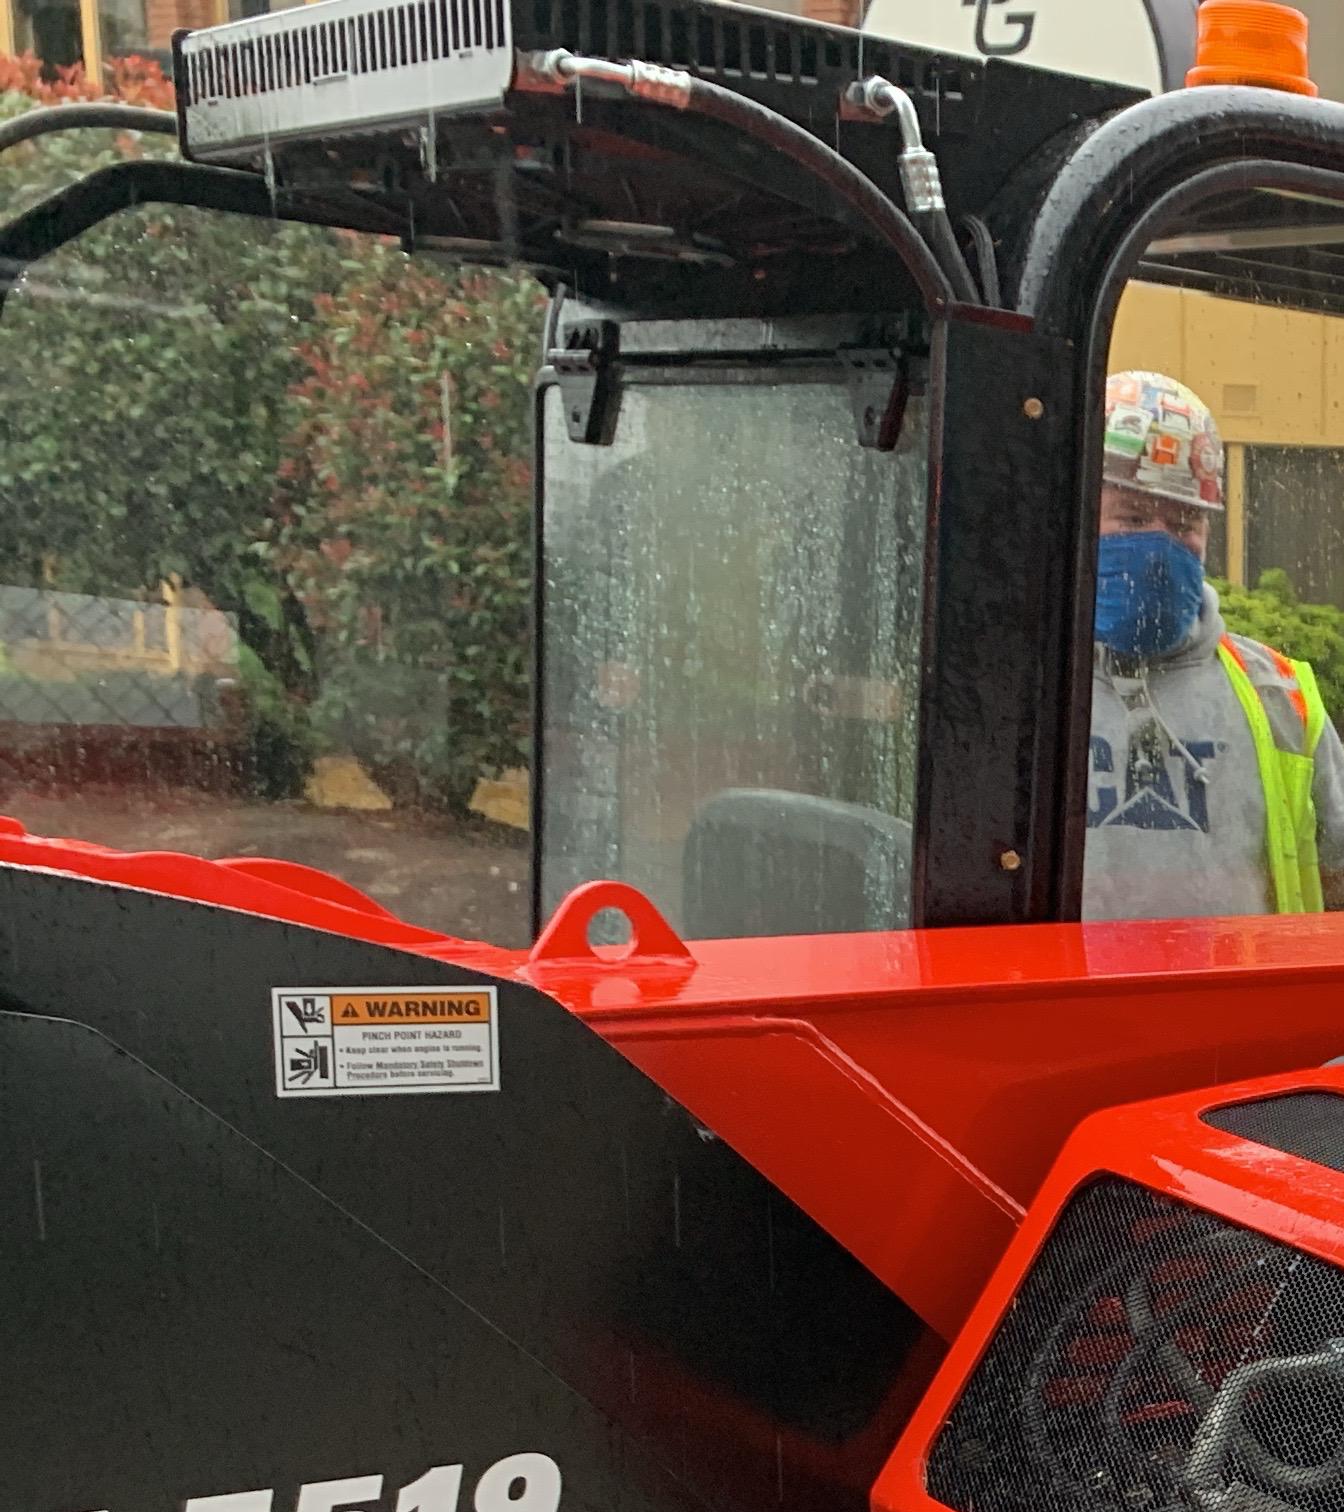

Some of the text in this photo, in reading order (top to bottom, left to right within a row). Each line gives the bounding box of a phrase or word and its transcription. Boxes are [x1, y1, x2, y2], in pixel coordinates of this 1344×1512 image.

[365, 999, 481, 1018] WARNING
[362, 1029, 462, 1041] PINCH POINT HAZARD
